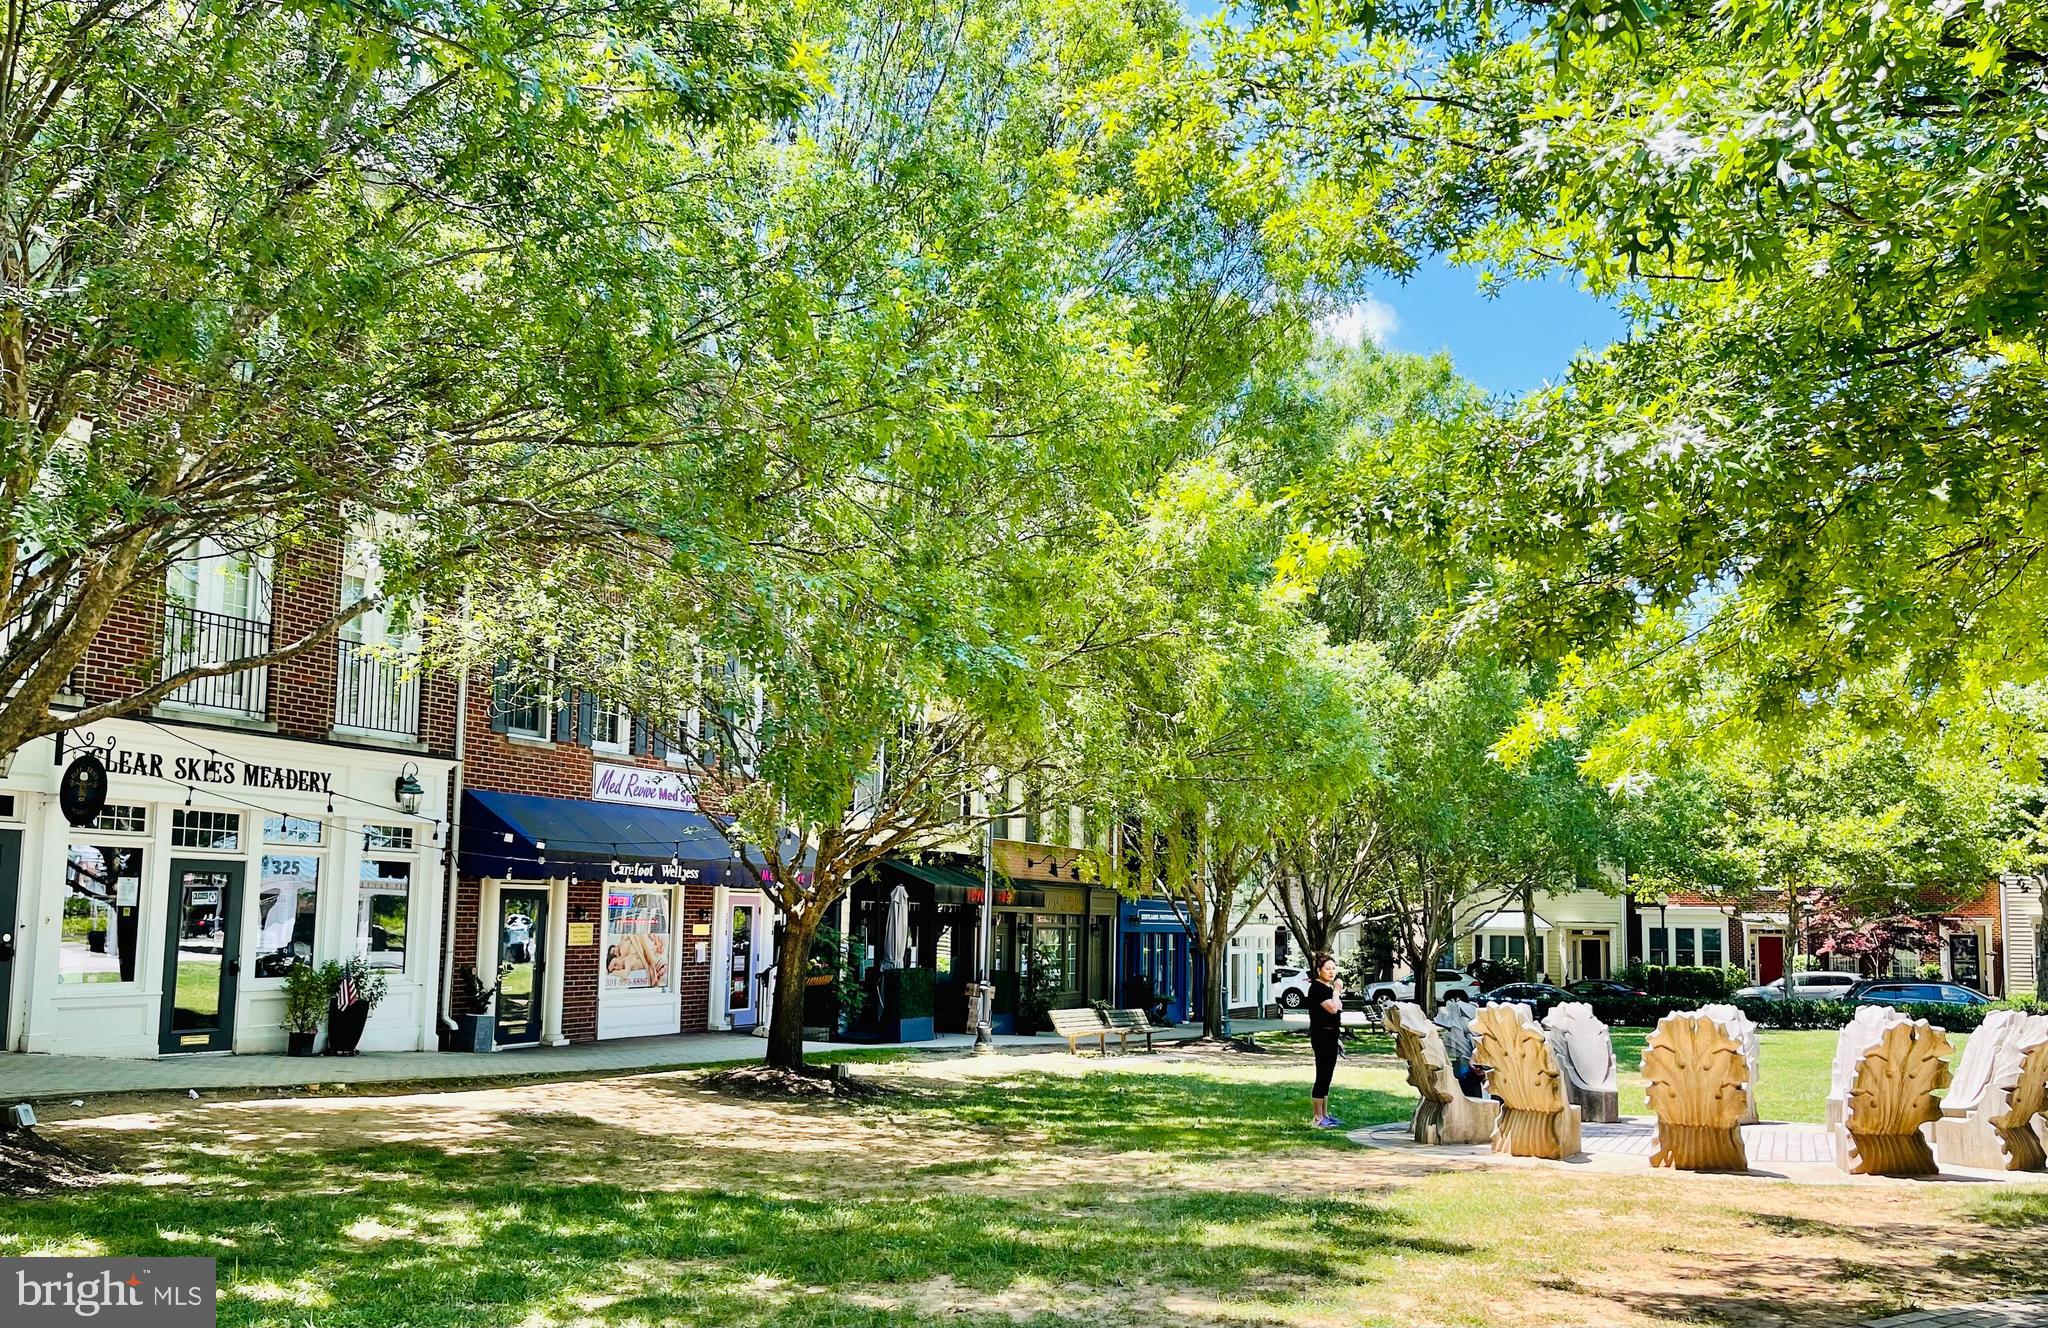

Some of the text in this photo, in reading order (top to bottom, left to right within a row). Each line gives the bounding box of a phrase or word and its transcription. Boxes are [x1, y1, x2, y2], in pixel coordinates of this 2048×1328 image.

[174, 757, 235, 784] SKIES
[243, 764, 332, 793] MEADERY
[596, 769, 625, 795] Med
[624, 773, 658, 798] Revive
[659, 787, 679, 801] Med
[272, 860, 301, 876] 325
[611, 863, 654, 877] Carefoot
[607, 895, 630, 907] OPEN
